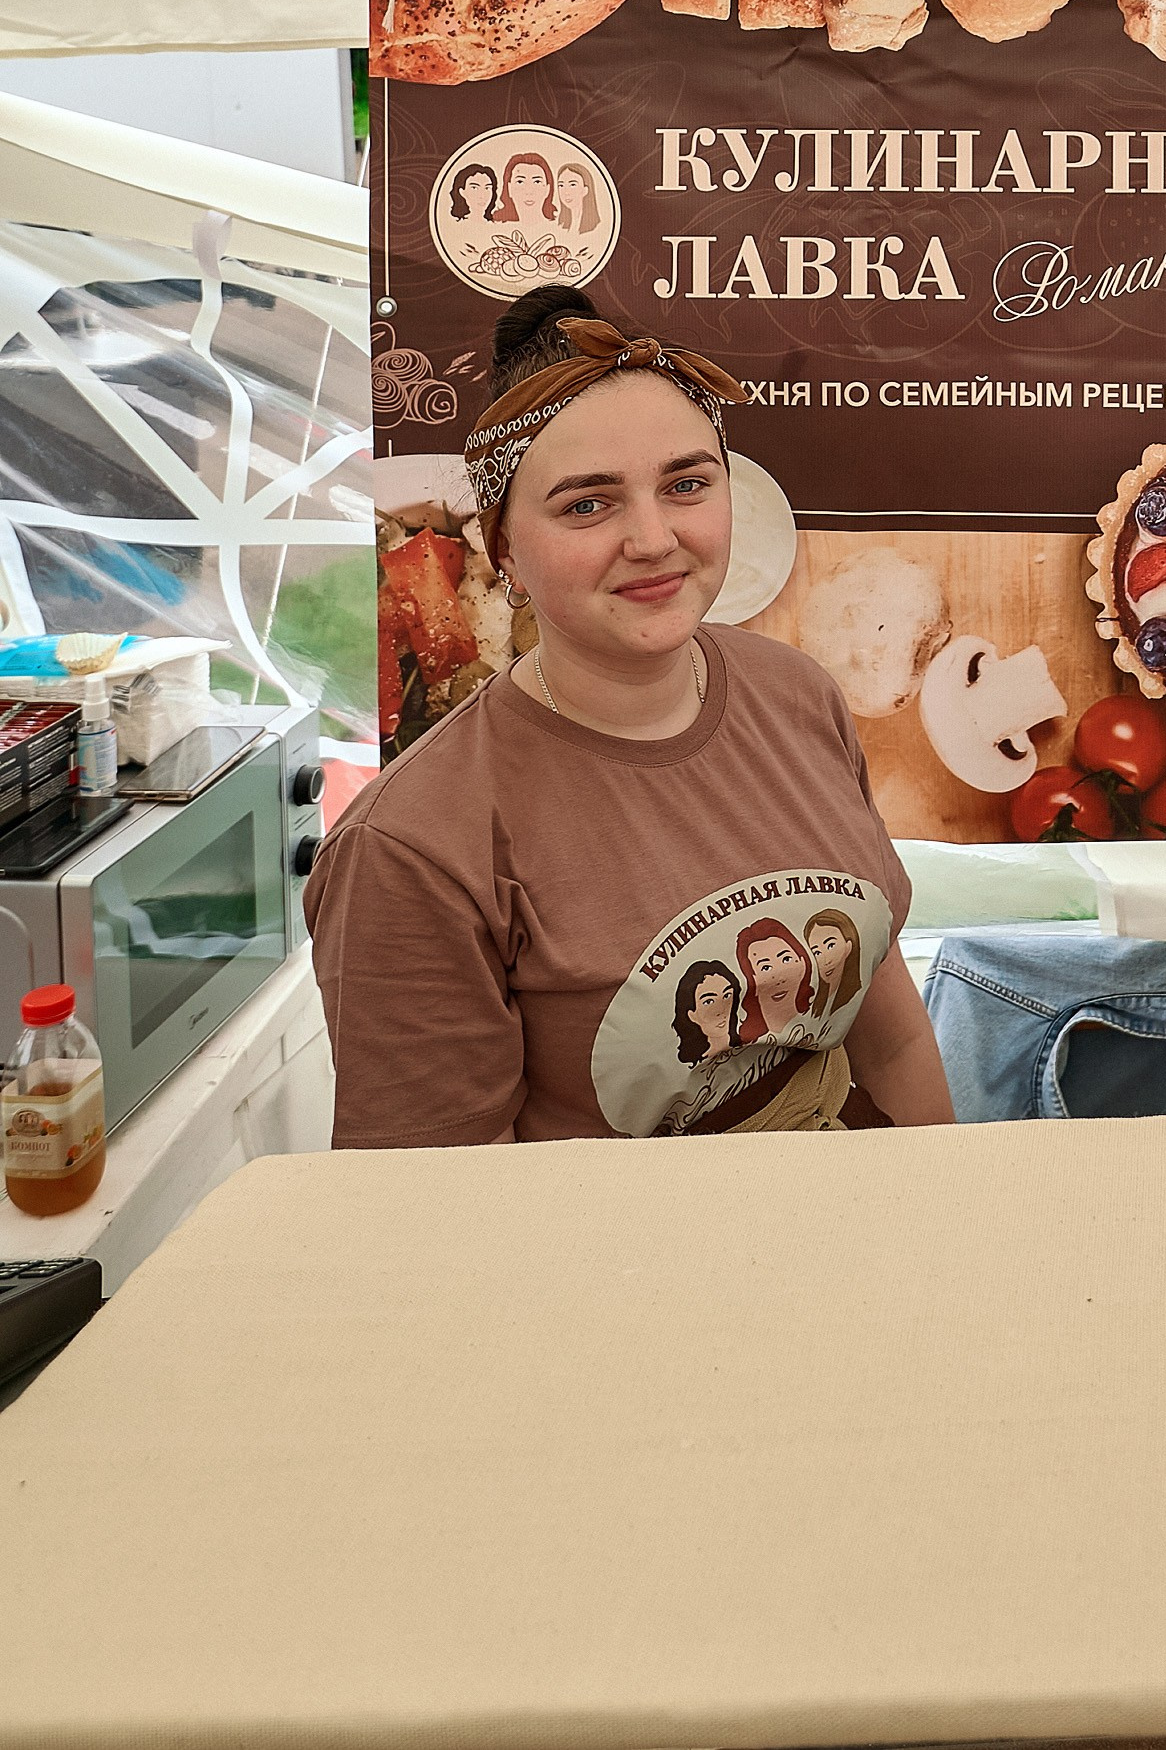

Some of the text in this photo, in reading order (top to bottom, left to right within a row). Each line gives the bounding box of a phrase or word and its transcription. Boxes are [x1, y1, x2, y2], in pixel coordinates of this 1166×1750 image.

[653, 235, 966, 301] ЛАВКА
[720, 380, 811, 407] ХНЯ
[821, 381, 870, 407] ПО
[879, 375, 1072, 408] СЕМЕЙНЫМ
[639, 876, 866, 982] КУЛИНАРНАЯ ЛАВКА
